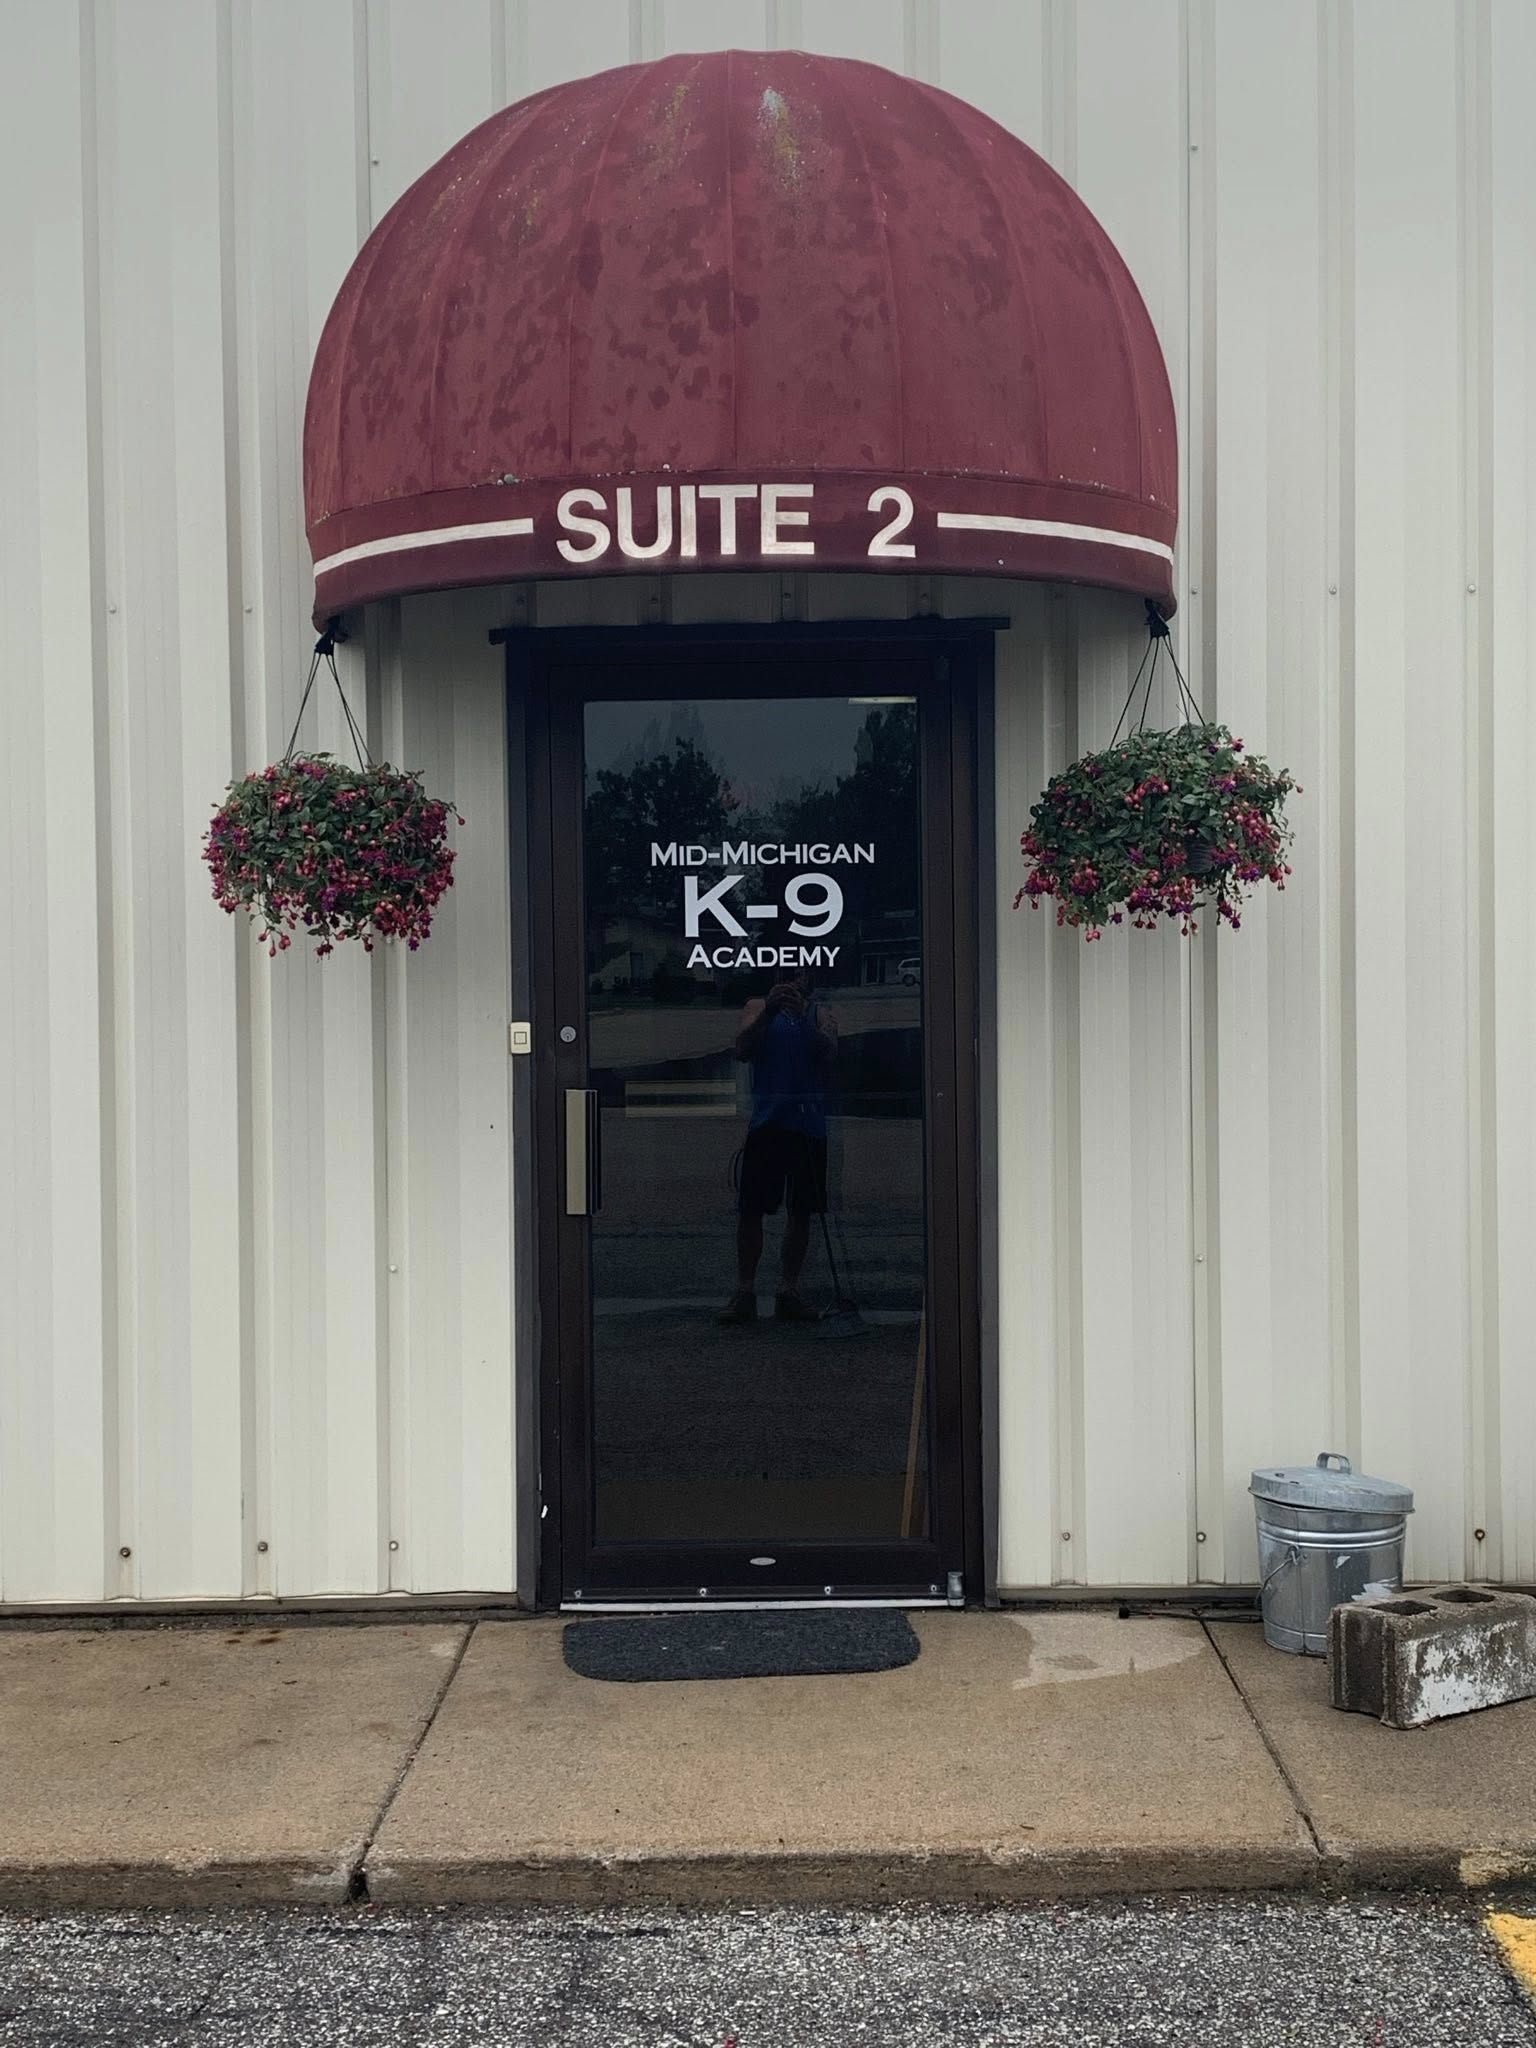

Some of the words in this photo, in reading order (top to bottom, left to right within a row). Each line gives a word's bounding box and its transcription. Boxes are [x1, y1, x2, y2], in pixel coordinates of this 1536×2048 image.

[556, 484, 815, 563] SUITE
[867, 486, 916, 558] 2
[650, 841, 875, 867] MID-MICHIGAN
[684, 872, 844, 938] K-9
[686, 944, 840, 969] ACADEMY
